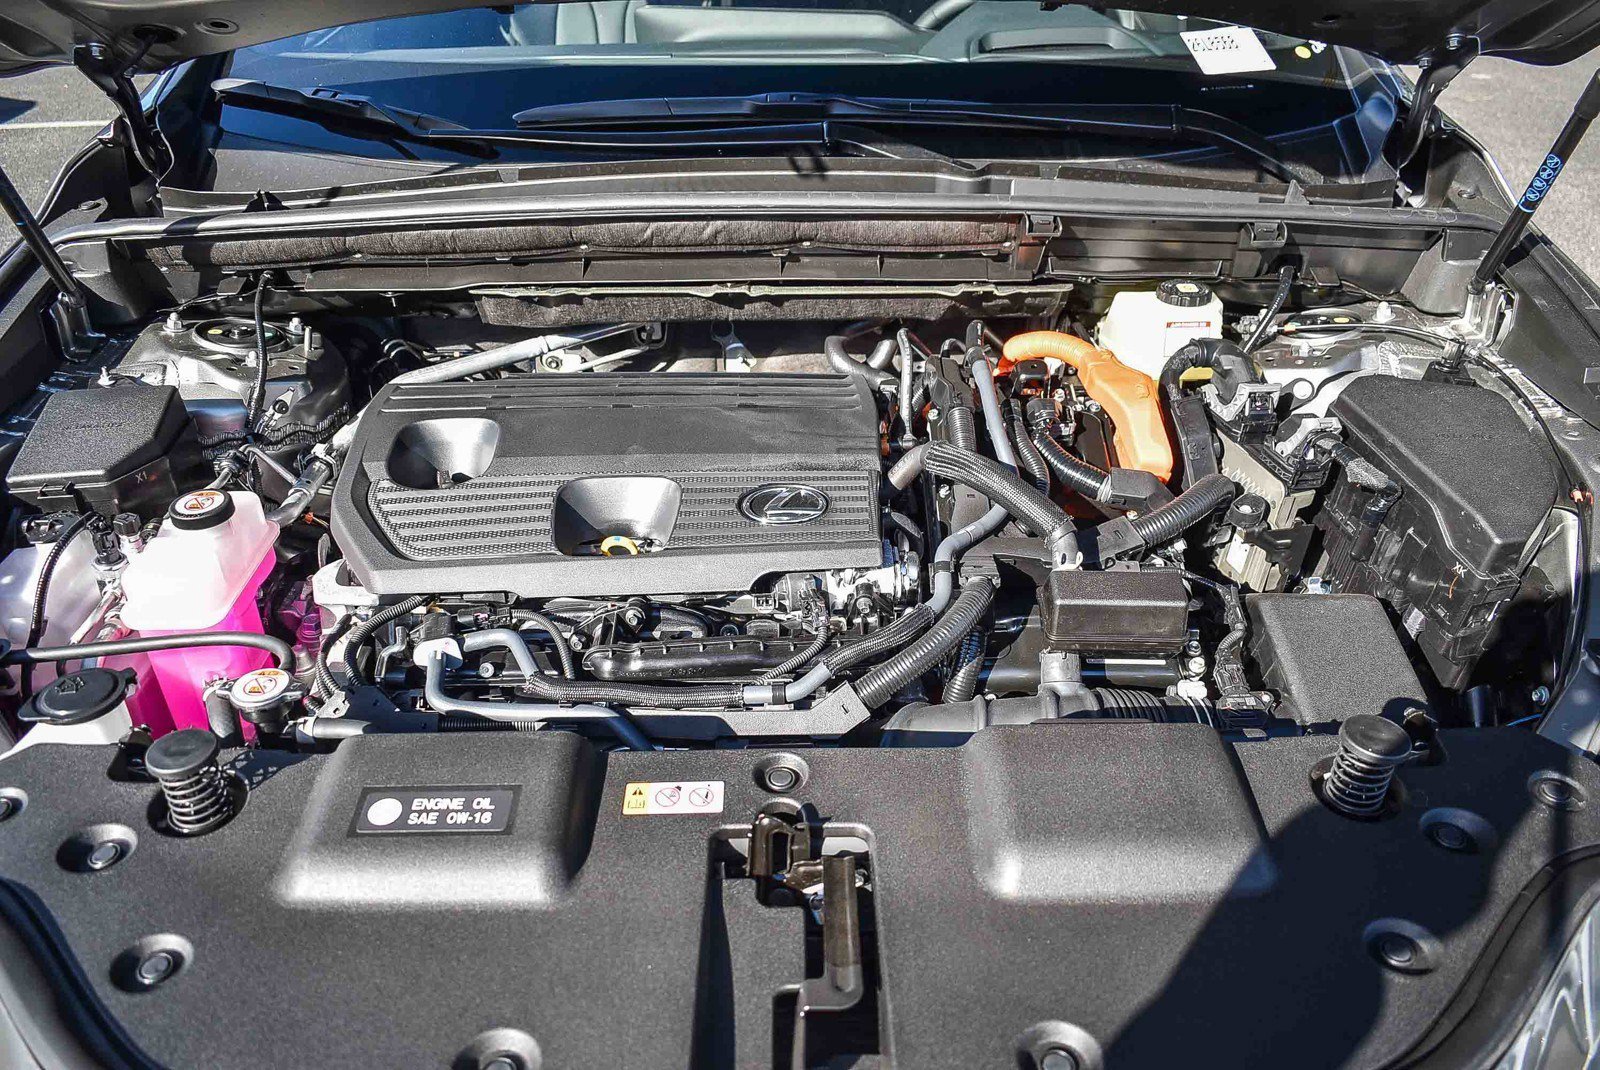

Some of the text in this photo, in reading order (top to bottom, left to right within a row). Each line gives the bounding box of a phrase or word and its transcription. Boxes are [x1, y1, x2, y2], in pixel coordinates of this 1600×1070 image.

[411, 797, 496, 811] ENGINE OIL
[407, 811, 493, 825] SAE 0W-16
